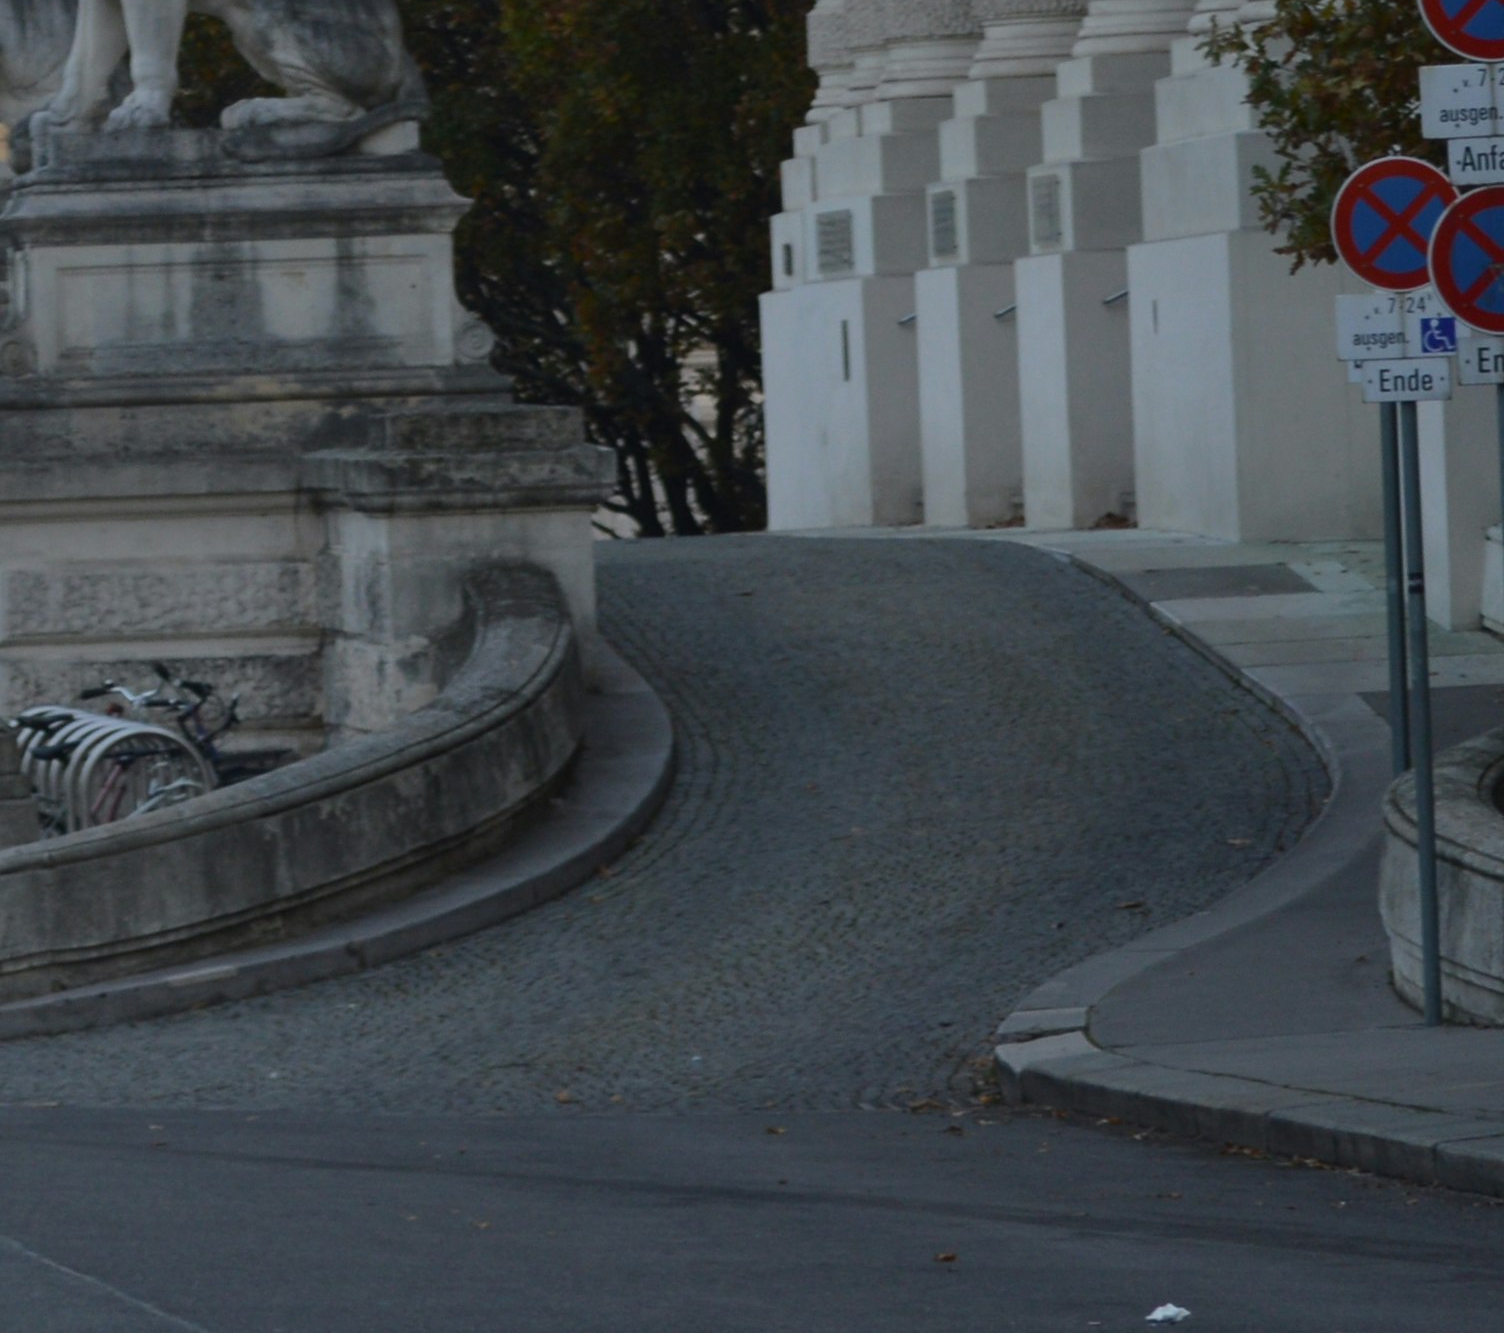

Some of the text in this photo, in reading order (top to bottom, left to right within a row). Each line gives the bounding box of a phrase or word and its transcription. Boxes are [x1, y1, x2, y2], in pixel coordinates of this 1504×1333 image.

[1439, 106, 1503, 126] ausgen.
[1352, 332, 1410, 349] ausgen.
[1378, 368, 1433, 392] Ende
